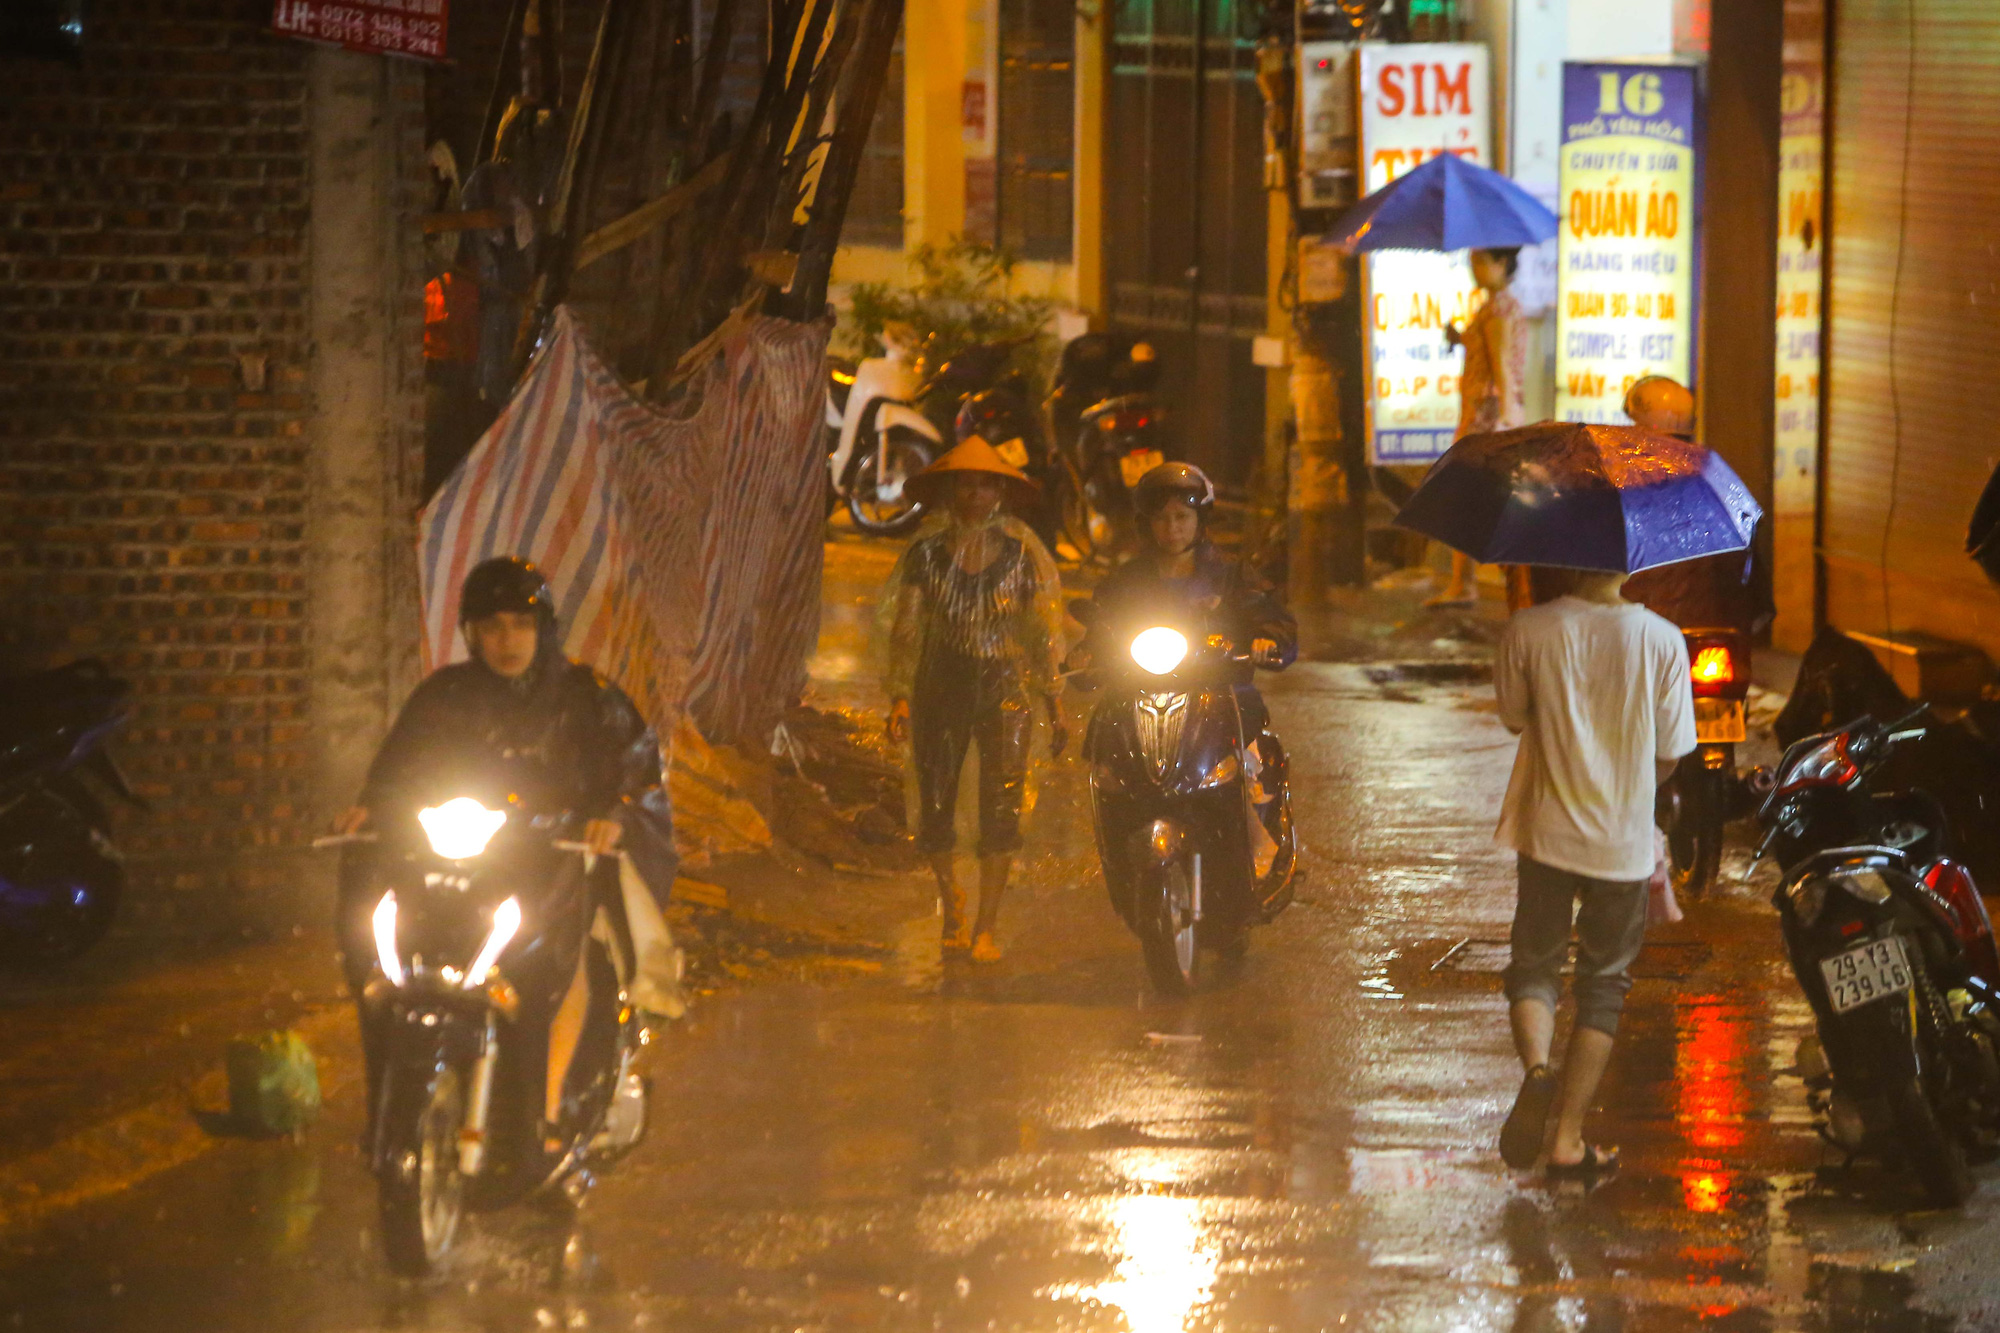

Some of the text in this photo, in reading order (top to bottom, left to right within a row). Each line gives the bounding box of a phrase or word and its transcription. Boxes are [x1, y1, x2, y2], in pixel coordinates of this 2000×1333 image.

[1377, 62, 1472, 117] SIM
[1596, 72, 1664, 116] 16
[1832, 943, 1891, 982] 29-Y3
